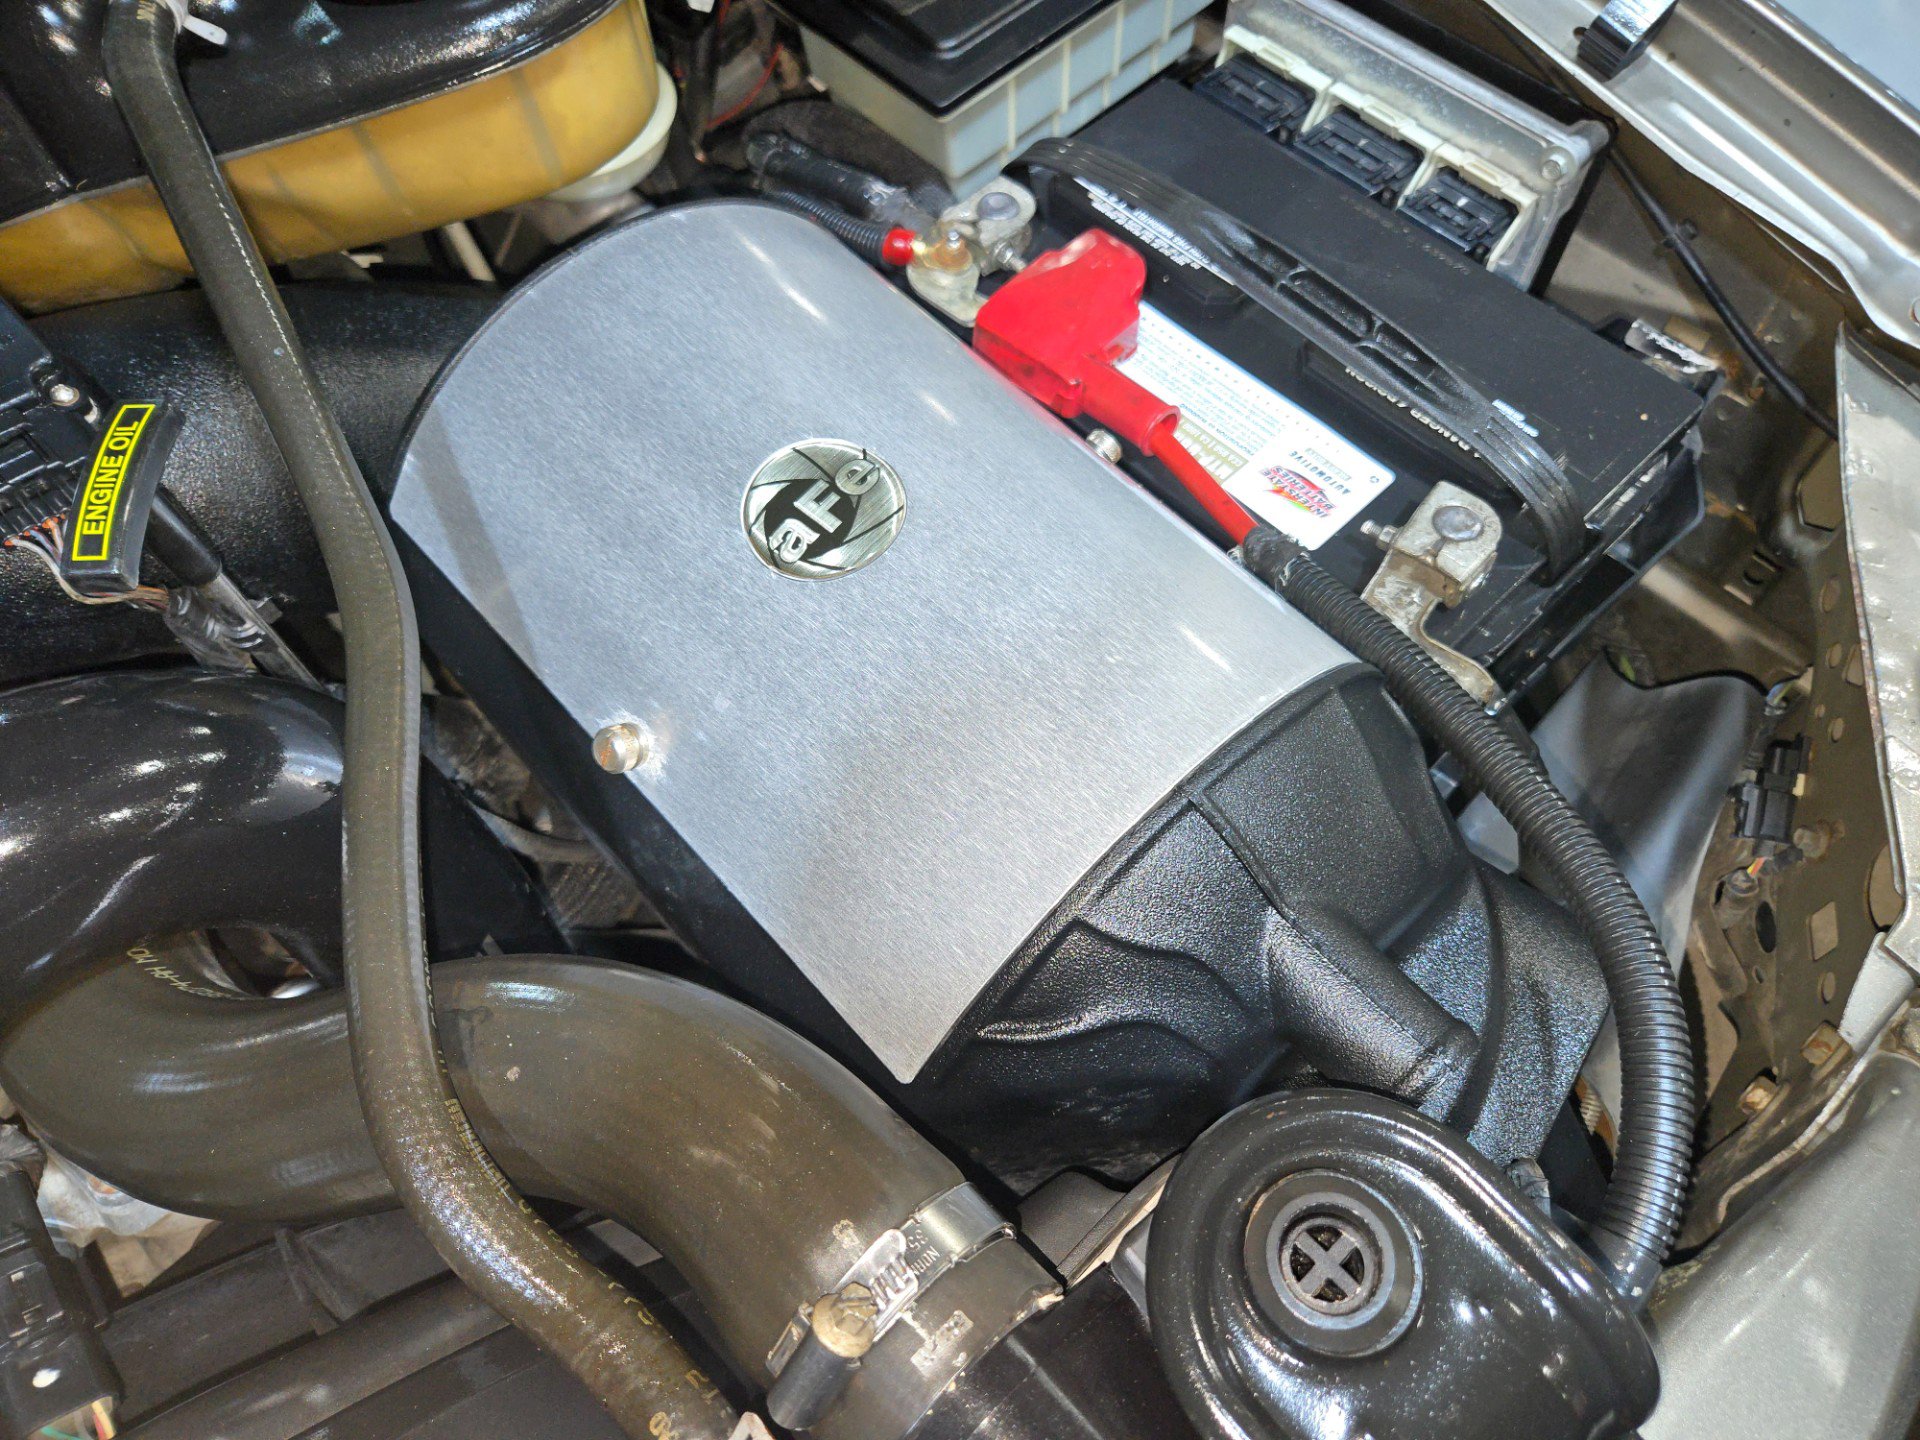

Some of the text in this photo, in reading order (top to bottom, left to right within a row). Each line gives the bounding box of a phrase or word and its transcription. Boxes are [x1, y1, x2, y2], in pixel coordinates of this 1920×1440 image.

[82, 421, 139, 535] ENGINE OIL
[1260, 469, 1328, 518] INTERSTATE
[1272, 466, 1333, 510] BATTERIES
[1288, 450, 1351, 494] AUTOMOTIVE
[770, 458, 881, 564] aFe
